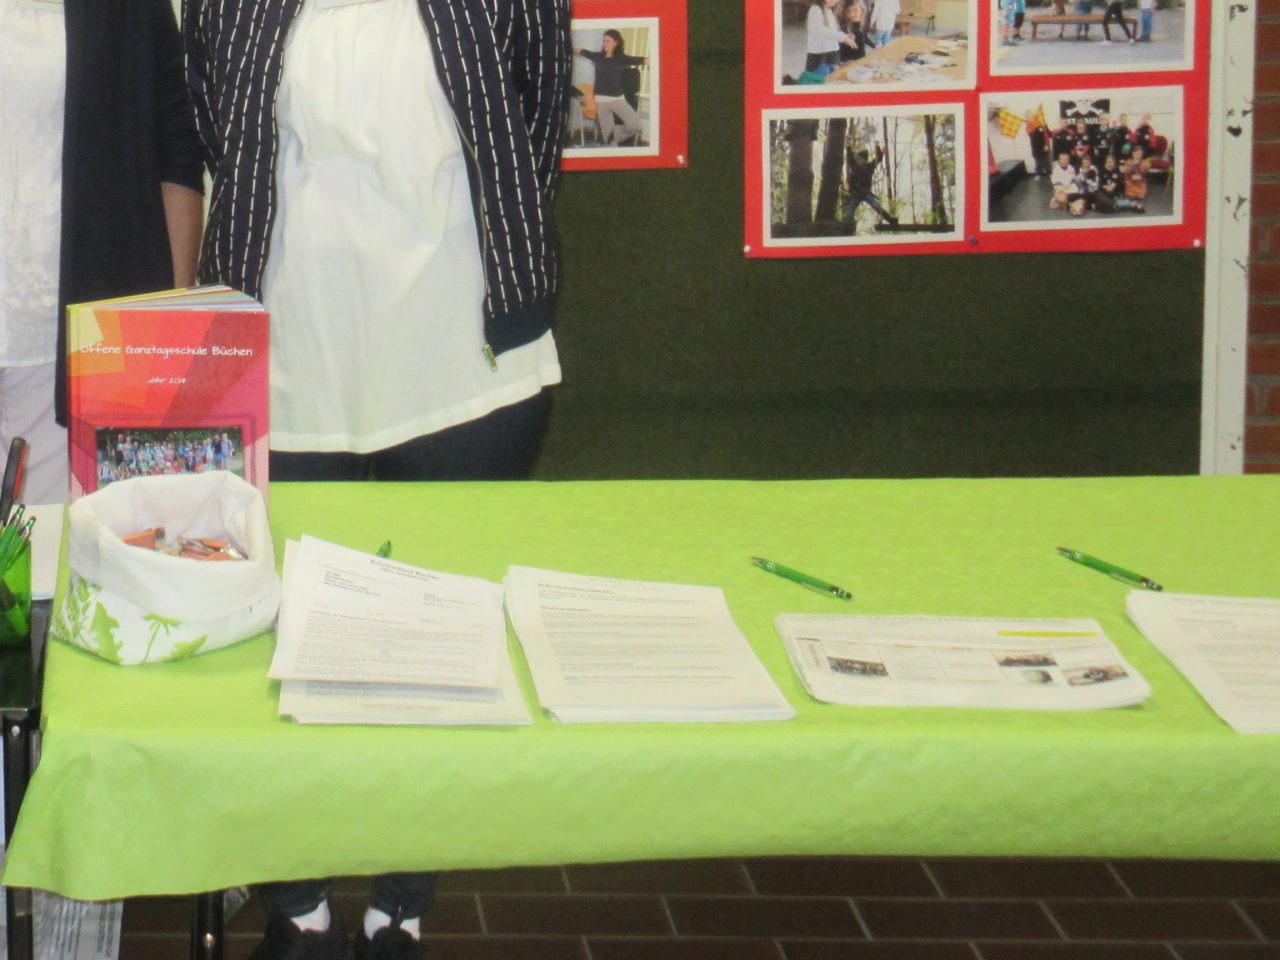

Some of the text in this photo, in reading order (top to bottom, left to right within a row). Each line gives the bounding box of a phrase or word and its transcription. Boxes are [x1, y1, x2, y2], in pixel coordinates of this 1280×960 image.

[80, 343, 253, 360] Offene Ganztagsschule Büchen
